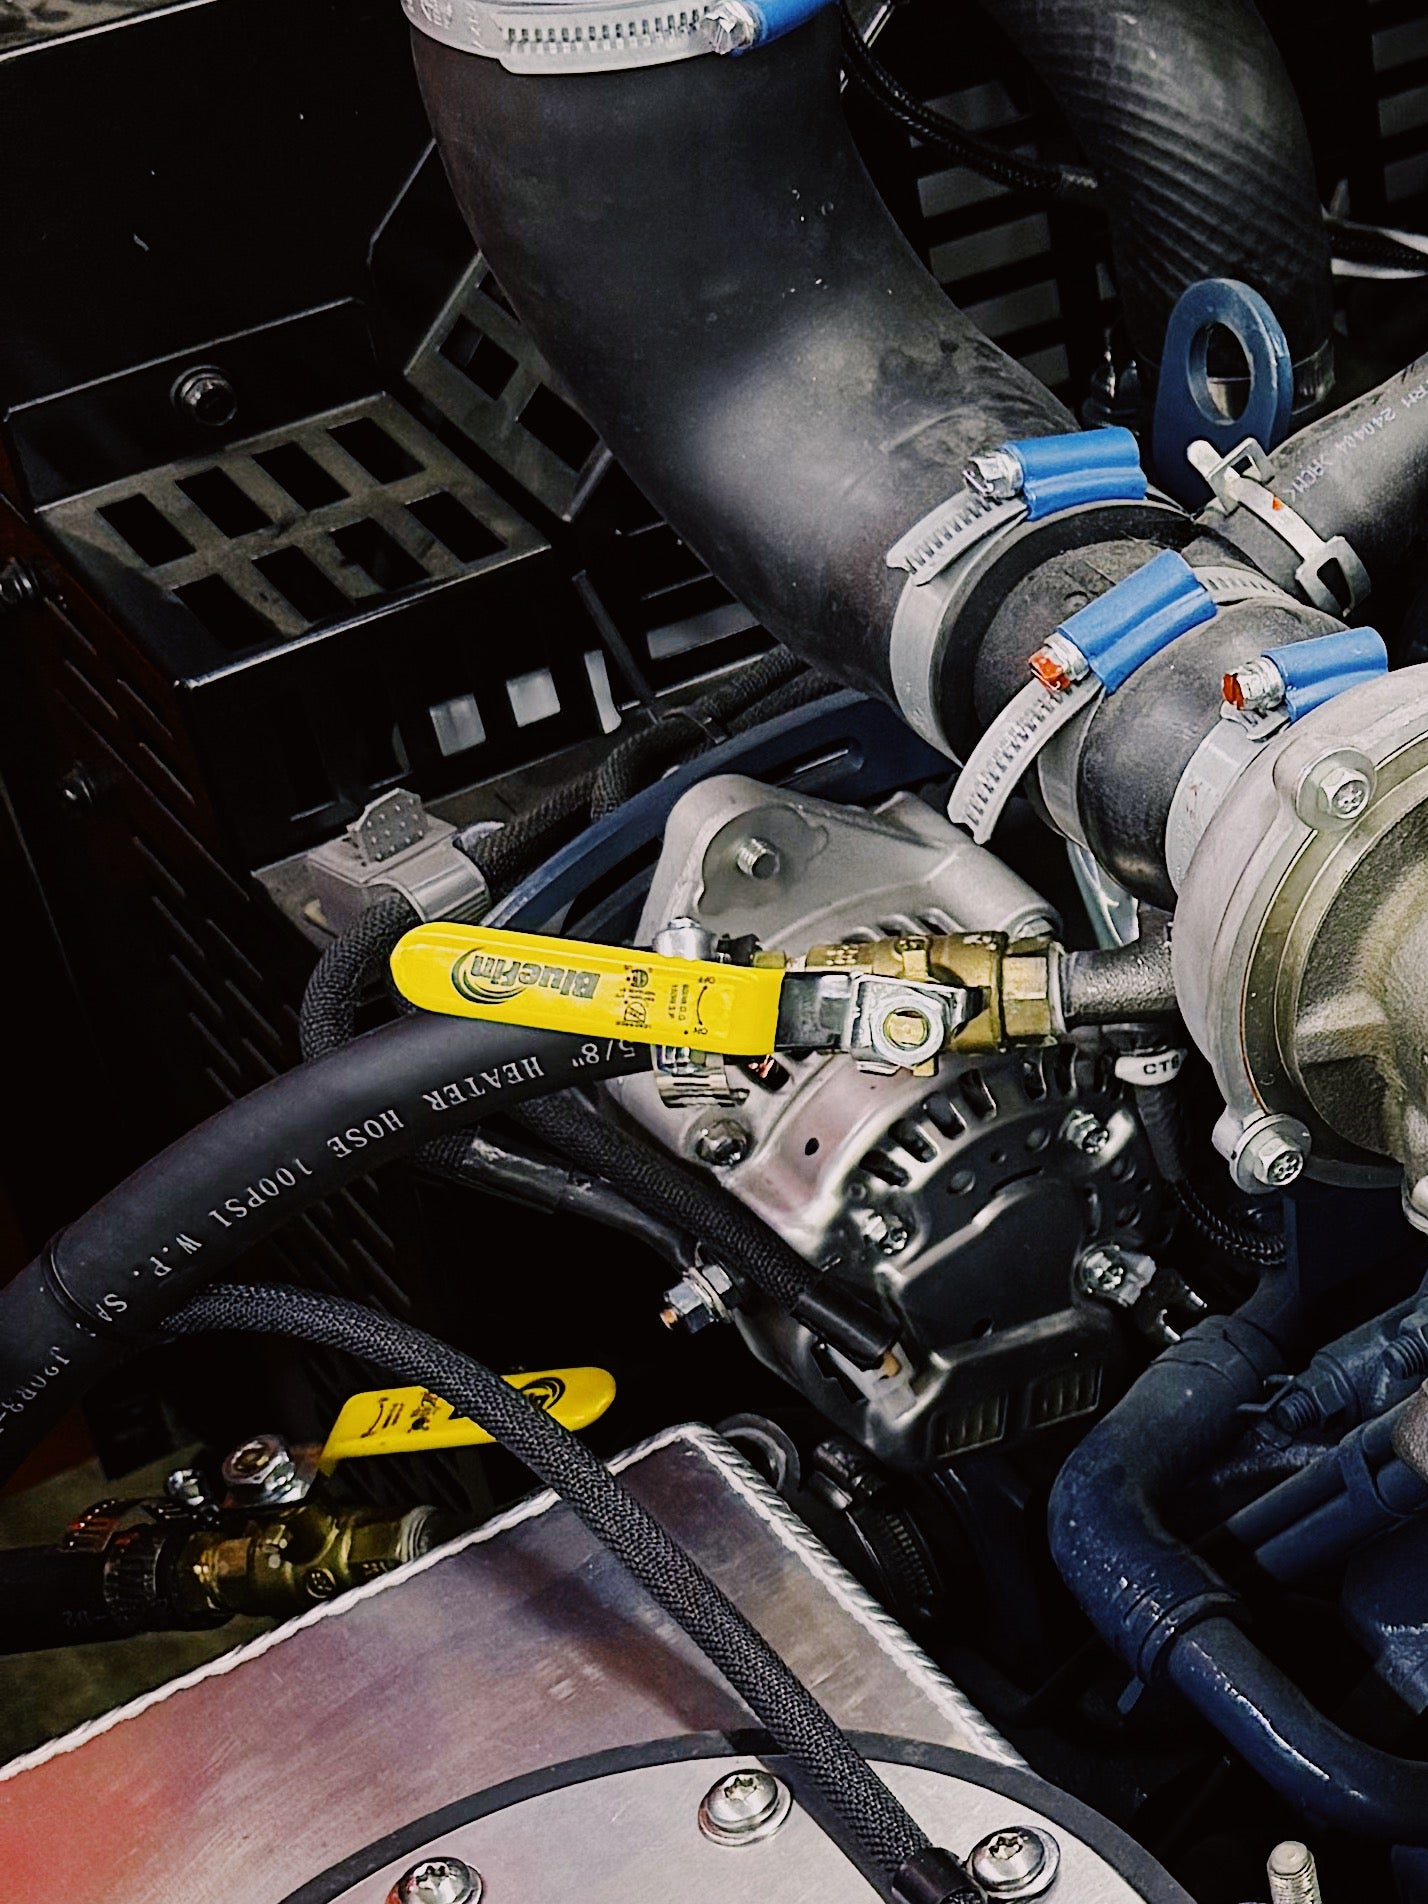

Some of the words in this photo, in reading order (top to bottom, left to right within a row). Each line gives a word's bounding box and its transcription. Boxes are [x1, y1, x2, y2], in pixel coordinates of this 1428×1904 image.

[421, 1055, 545, 1113] HEATER
[326, 1108, 405, 1160] HOSE
[208, 1158, 313, 1230] 100PSI
